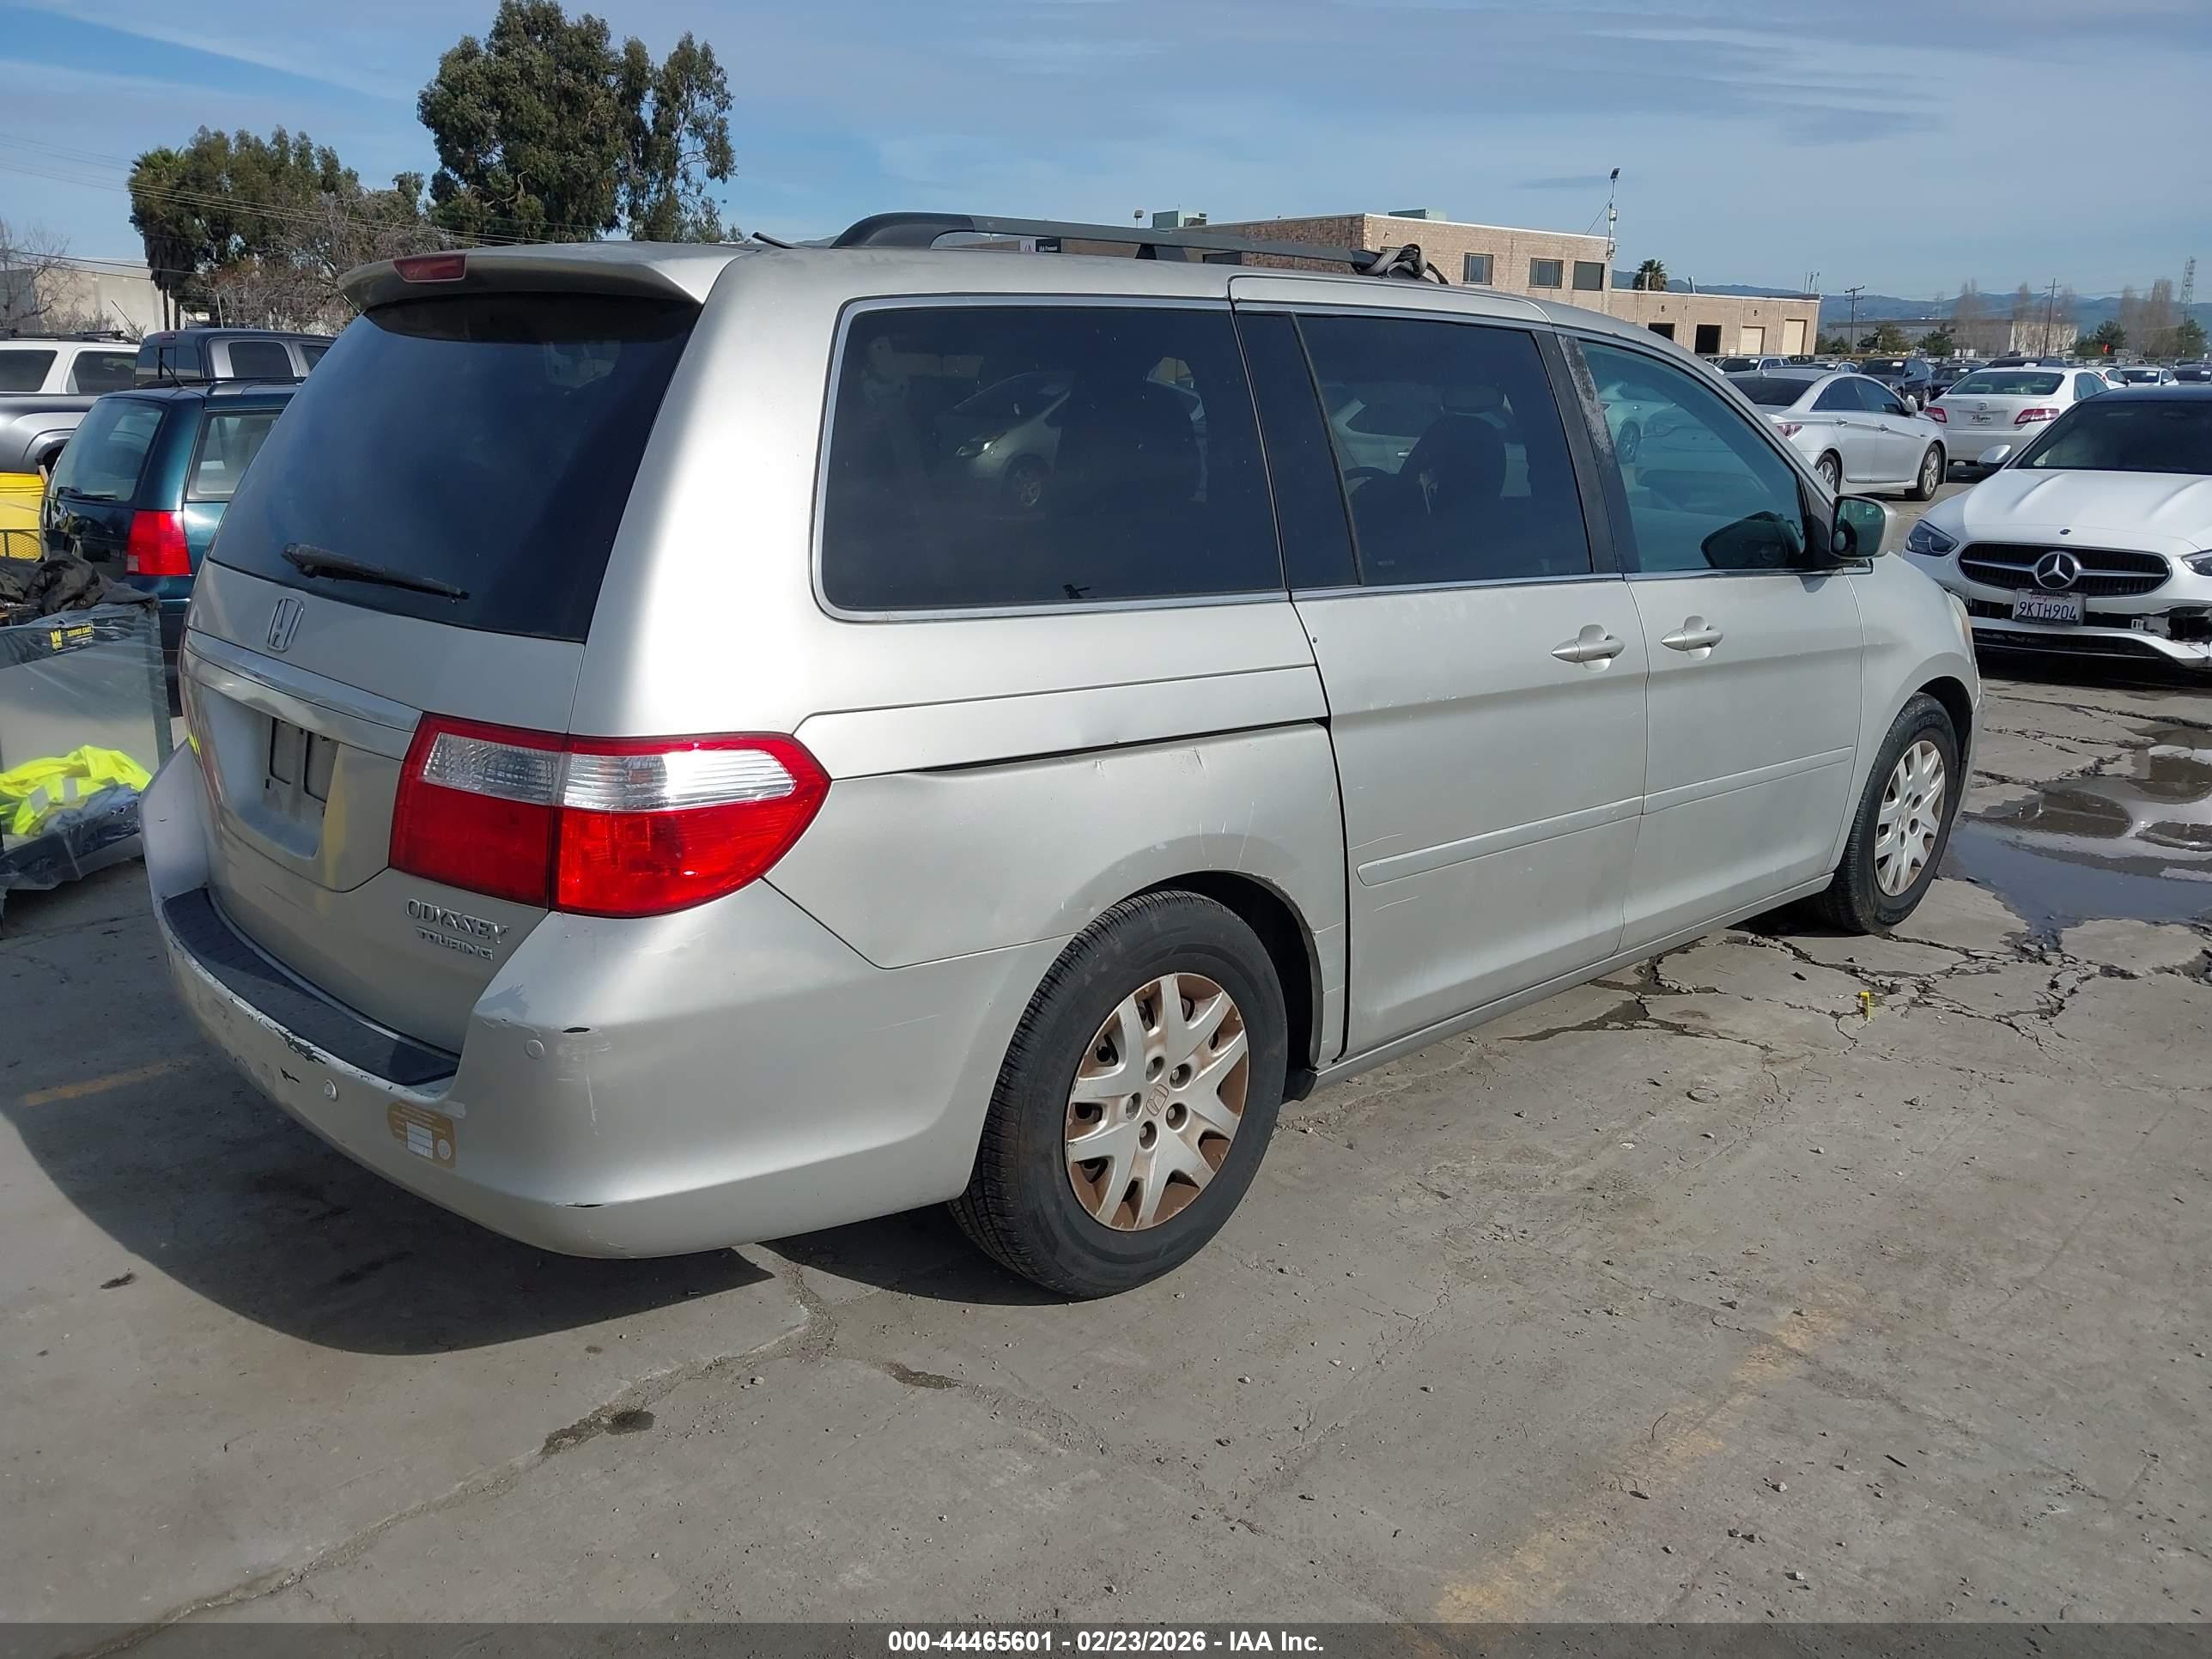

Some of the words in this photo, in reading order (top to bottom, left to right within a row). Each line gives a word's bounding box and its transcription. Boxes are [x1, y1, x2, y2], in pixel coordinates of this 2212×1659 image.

[2018, 601, 2077, 621] 9KTH904
[406, 898, 509, 945] ODYSSEY
[416, 926, 494, 962] TOURING
